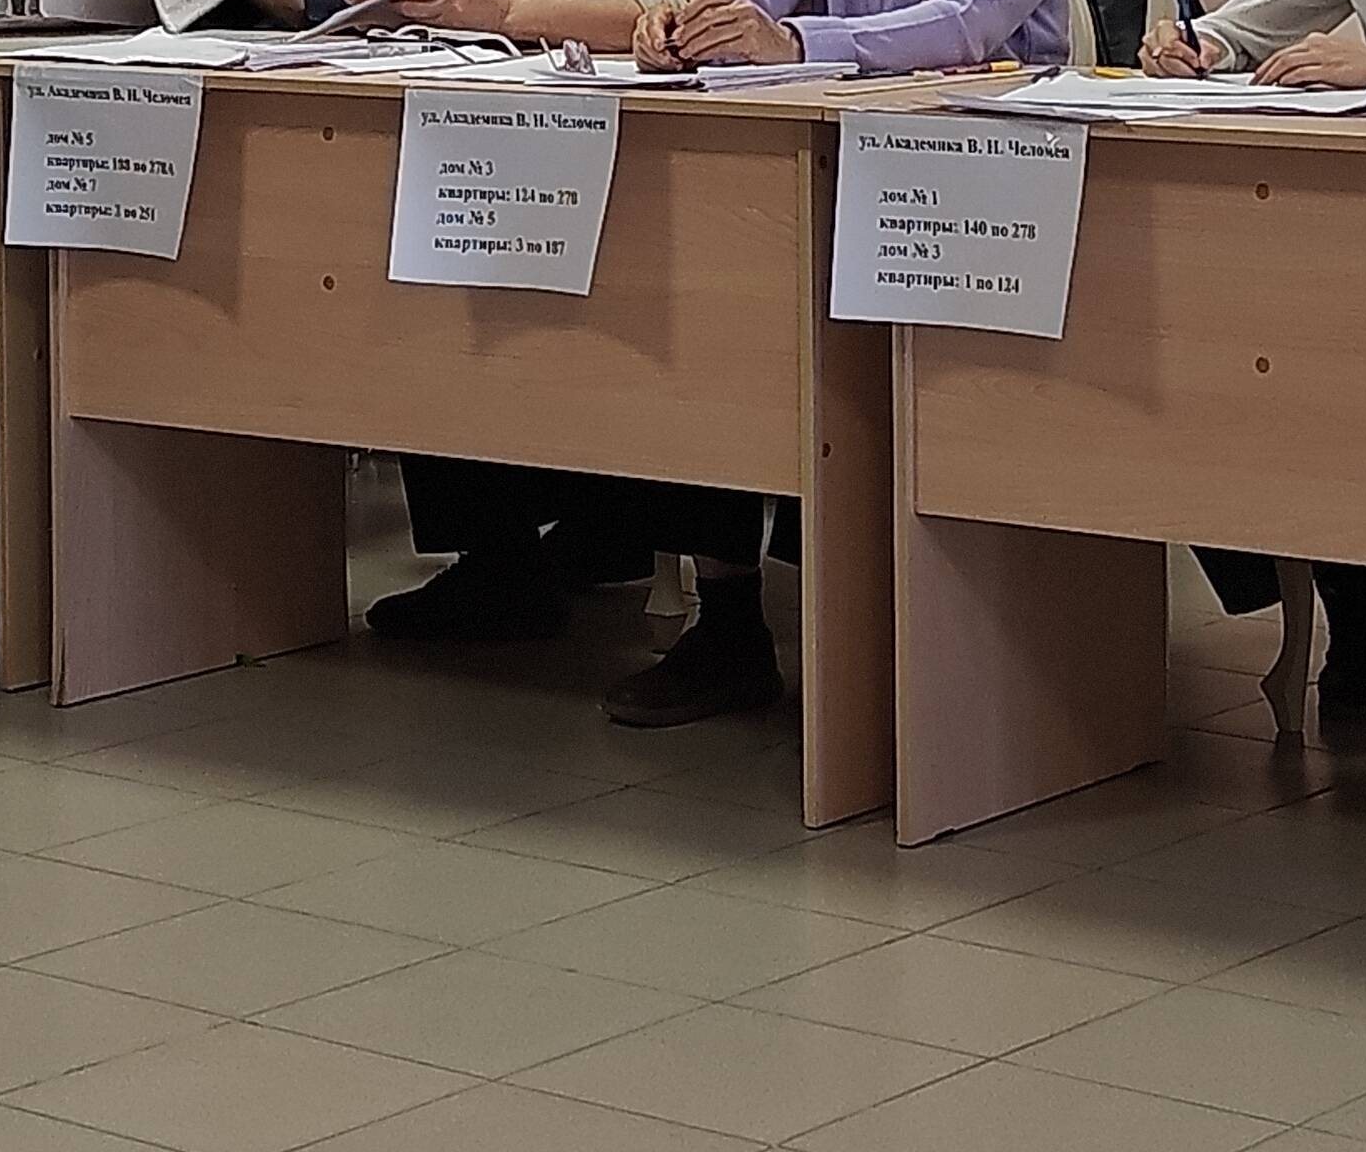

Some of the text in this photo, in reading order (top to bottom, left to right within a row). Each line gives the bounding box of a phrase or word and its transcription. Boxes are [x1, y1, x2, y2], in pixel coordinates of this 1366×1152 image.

[421, 111, 441, 127] ул.
[443, 110, 513, 127] Академика
[551, 113, 606, 130] Челомея
[859, 134, 1070, 159] ул. Академика В. Н. Челомея
[439, 160, 494, 177] дом № 3
[438, 188, 511, 205] квартиры:
[539, 192, 555, 204] по
[879, 188, 938, 206] дом № 1
[436, 210, 496, 226] дом № 5
[879, 217, 958, 237] квартиры:
[964, 219, 987, 236] 140
[991, 225, 1009, 238] по
[434, 238, 512, 255] квартиры:
[526, 242, 543, 254] по
[878, 242, 941, 260] дом № 3
[877, 271, 1020, 294] квартиры: 1 по 124
